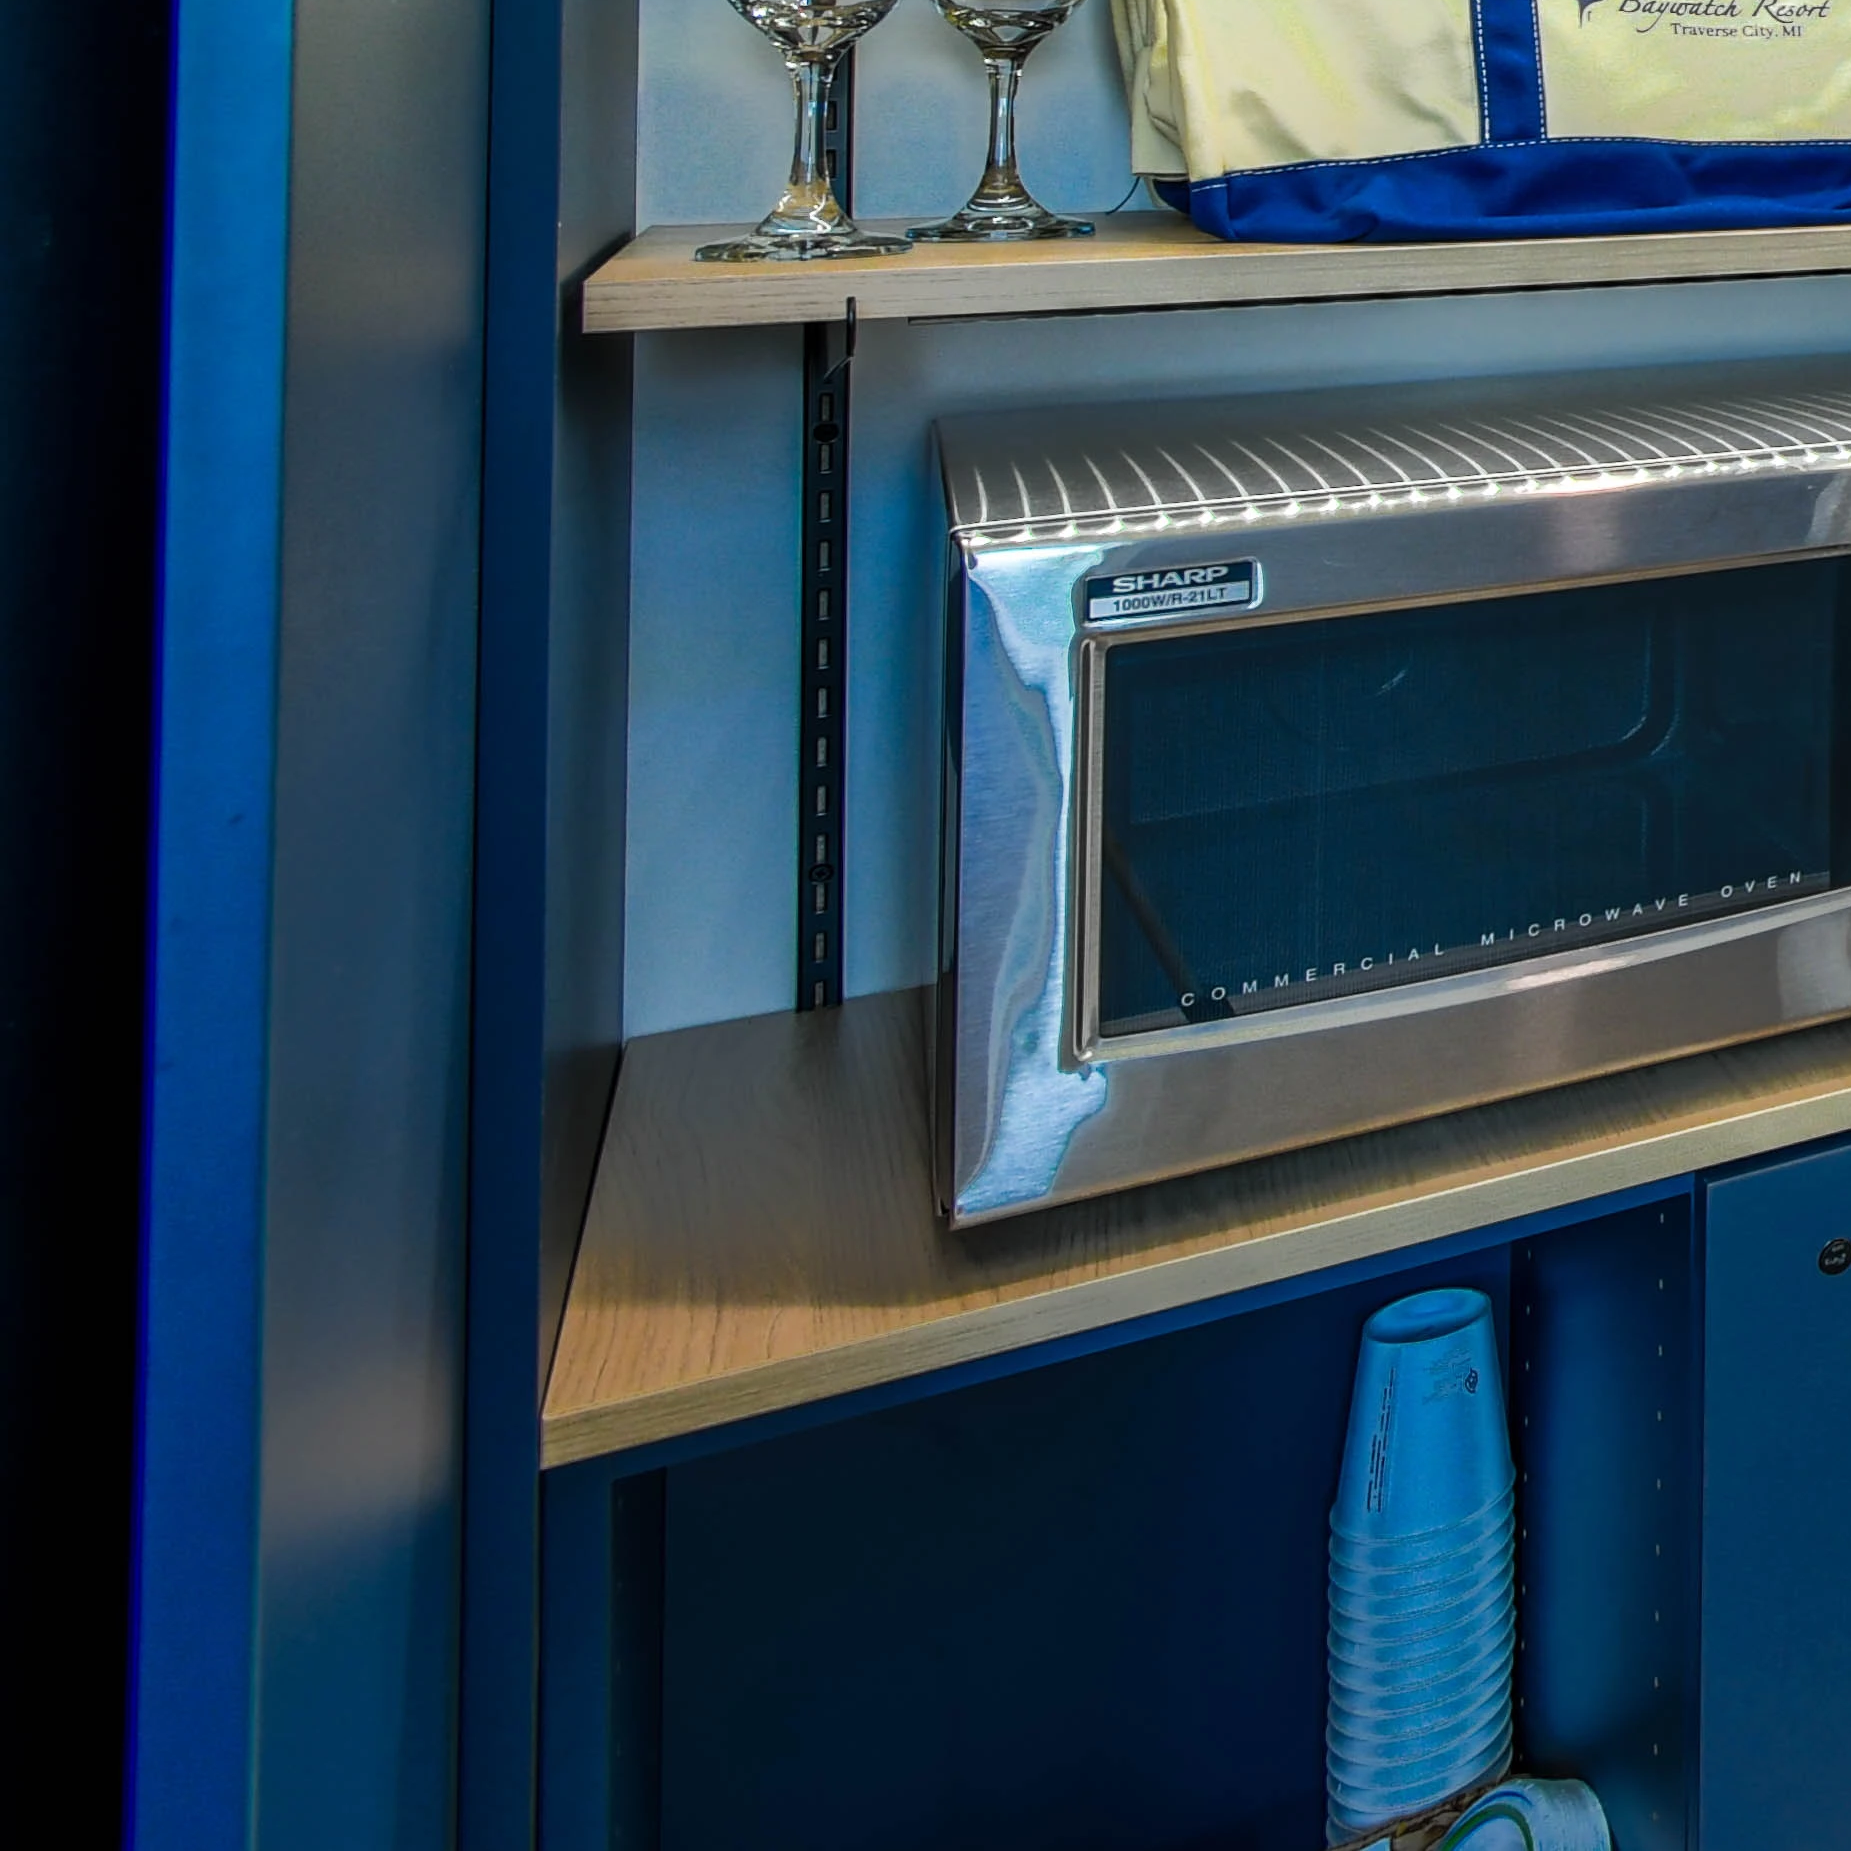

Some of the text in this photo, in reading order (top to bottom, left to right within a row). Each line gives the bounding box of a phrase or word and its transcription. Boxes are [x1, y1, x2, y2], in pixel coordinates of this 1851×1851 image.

[1670, 22, 1802, 38] Traverse MI
[1112, 565, 1230, 593] SHARP
[1112, 586, 1228, 613] 1000W/R-21LT
[1181, 870, 1803, 1007] COMMERCIAL MICROWAVE OVEN
